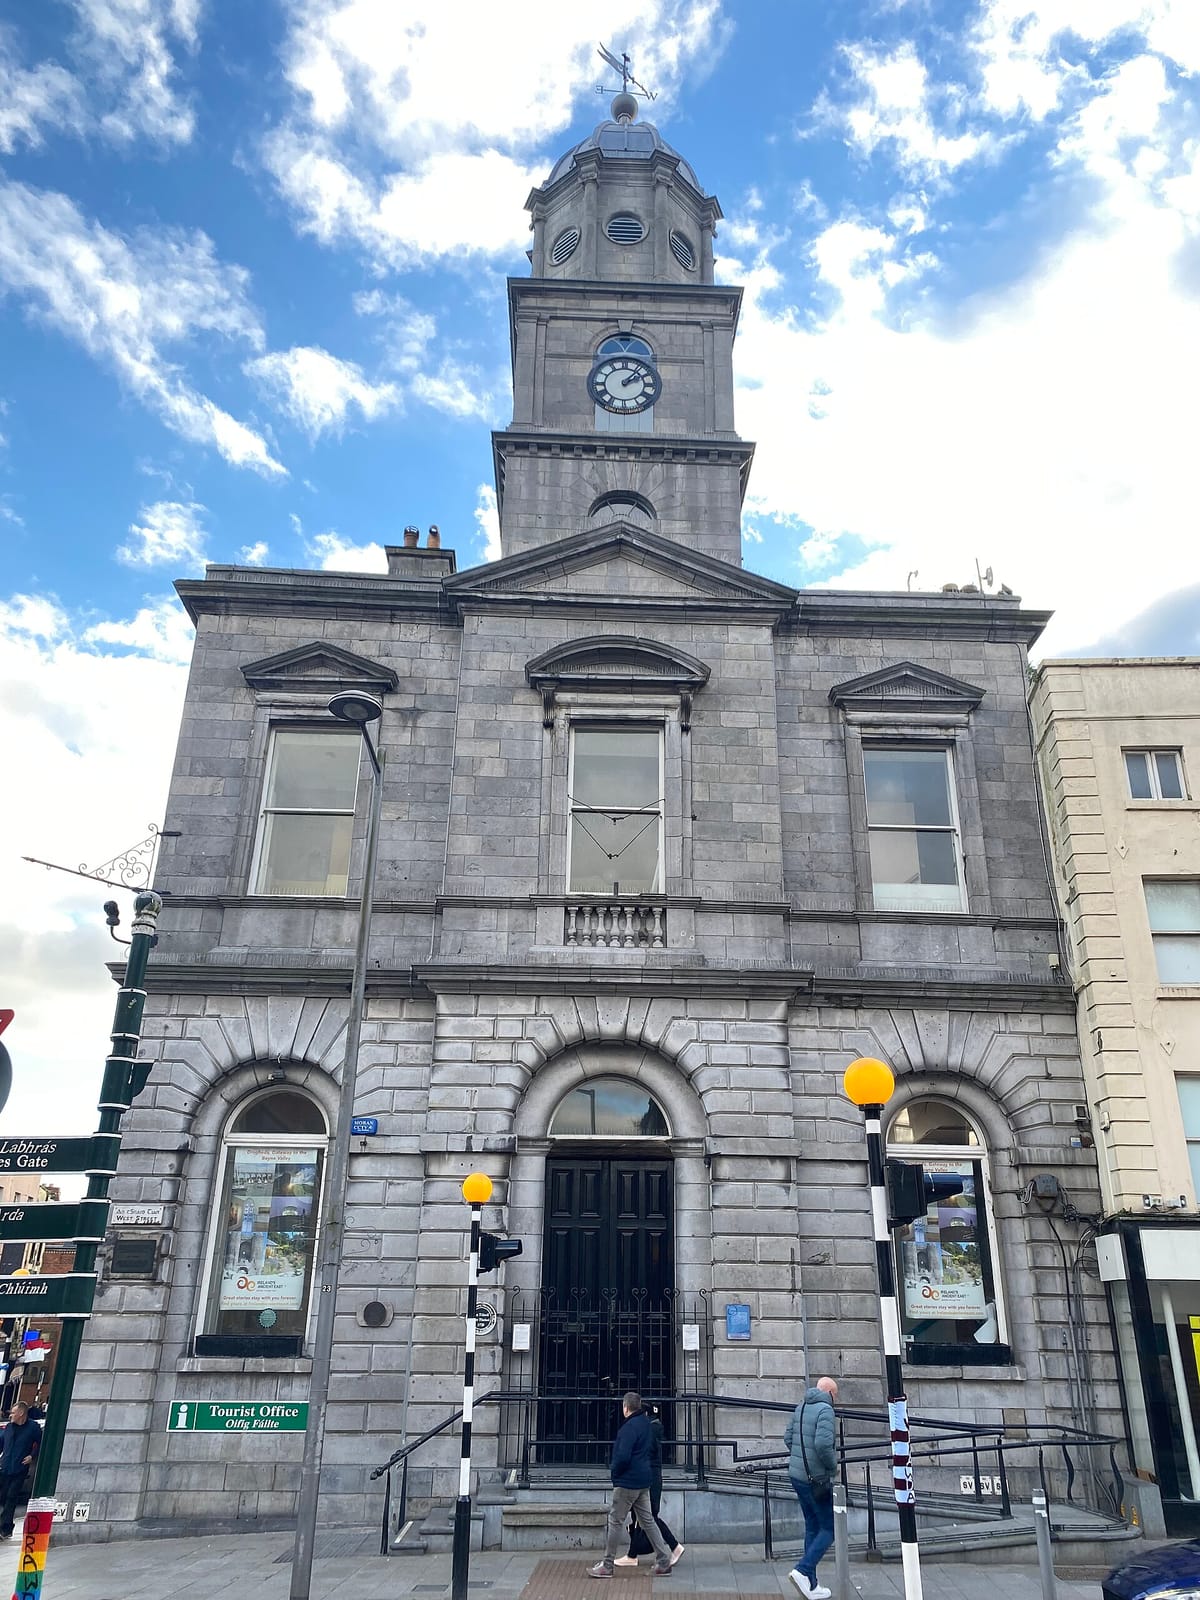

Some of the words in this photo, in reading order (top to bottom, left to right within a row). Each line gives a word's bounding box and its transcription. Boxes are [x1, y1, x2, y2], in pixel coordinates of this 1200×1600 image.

[0, 1141, 57, 1154] Labhrás
[17, 1154, 48, 1168] Gate
[321, 1285, 332, 1293] 23
[209, 1405, 255, 1417] Tourist
[260, 1405, 299, 1417] Office
[225, 1418, 250, 1430] Oifig
[980, 1482, 990, 1490] SV
[75, 1509, 87, 1517] SV
